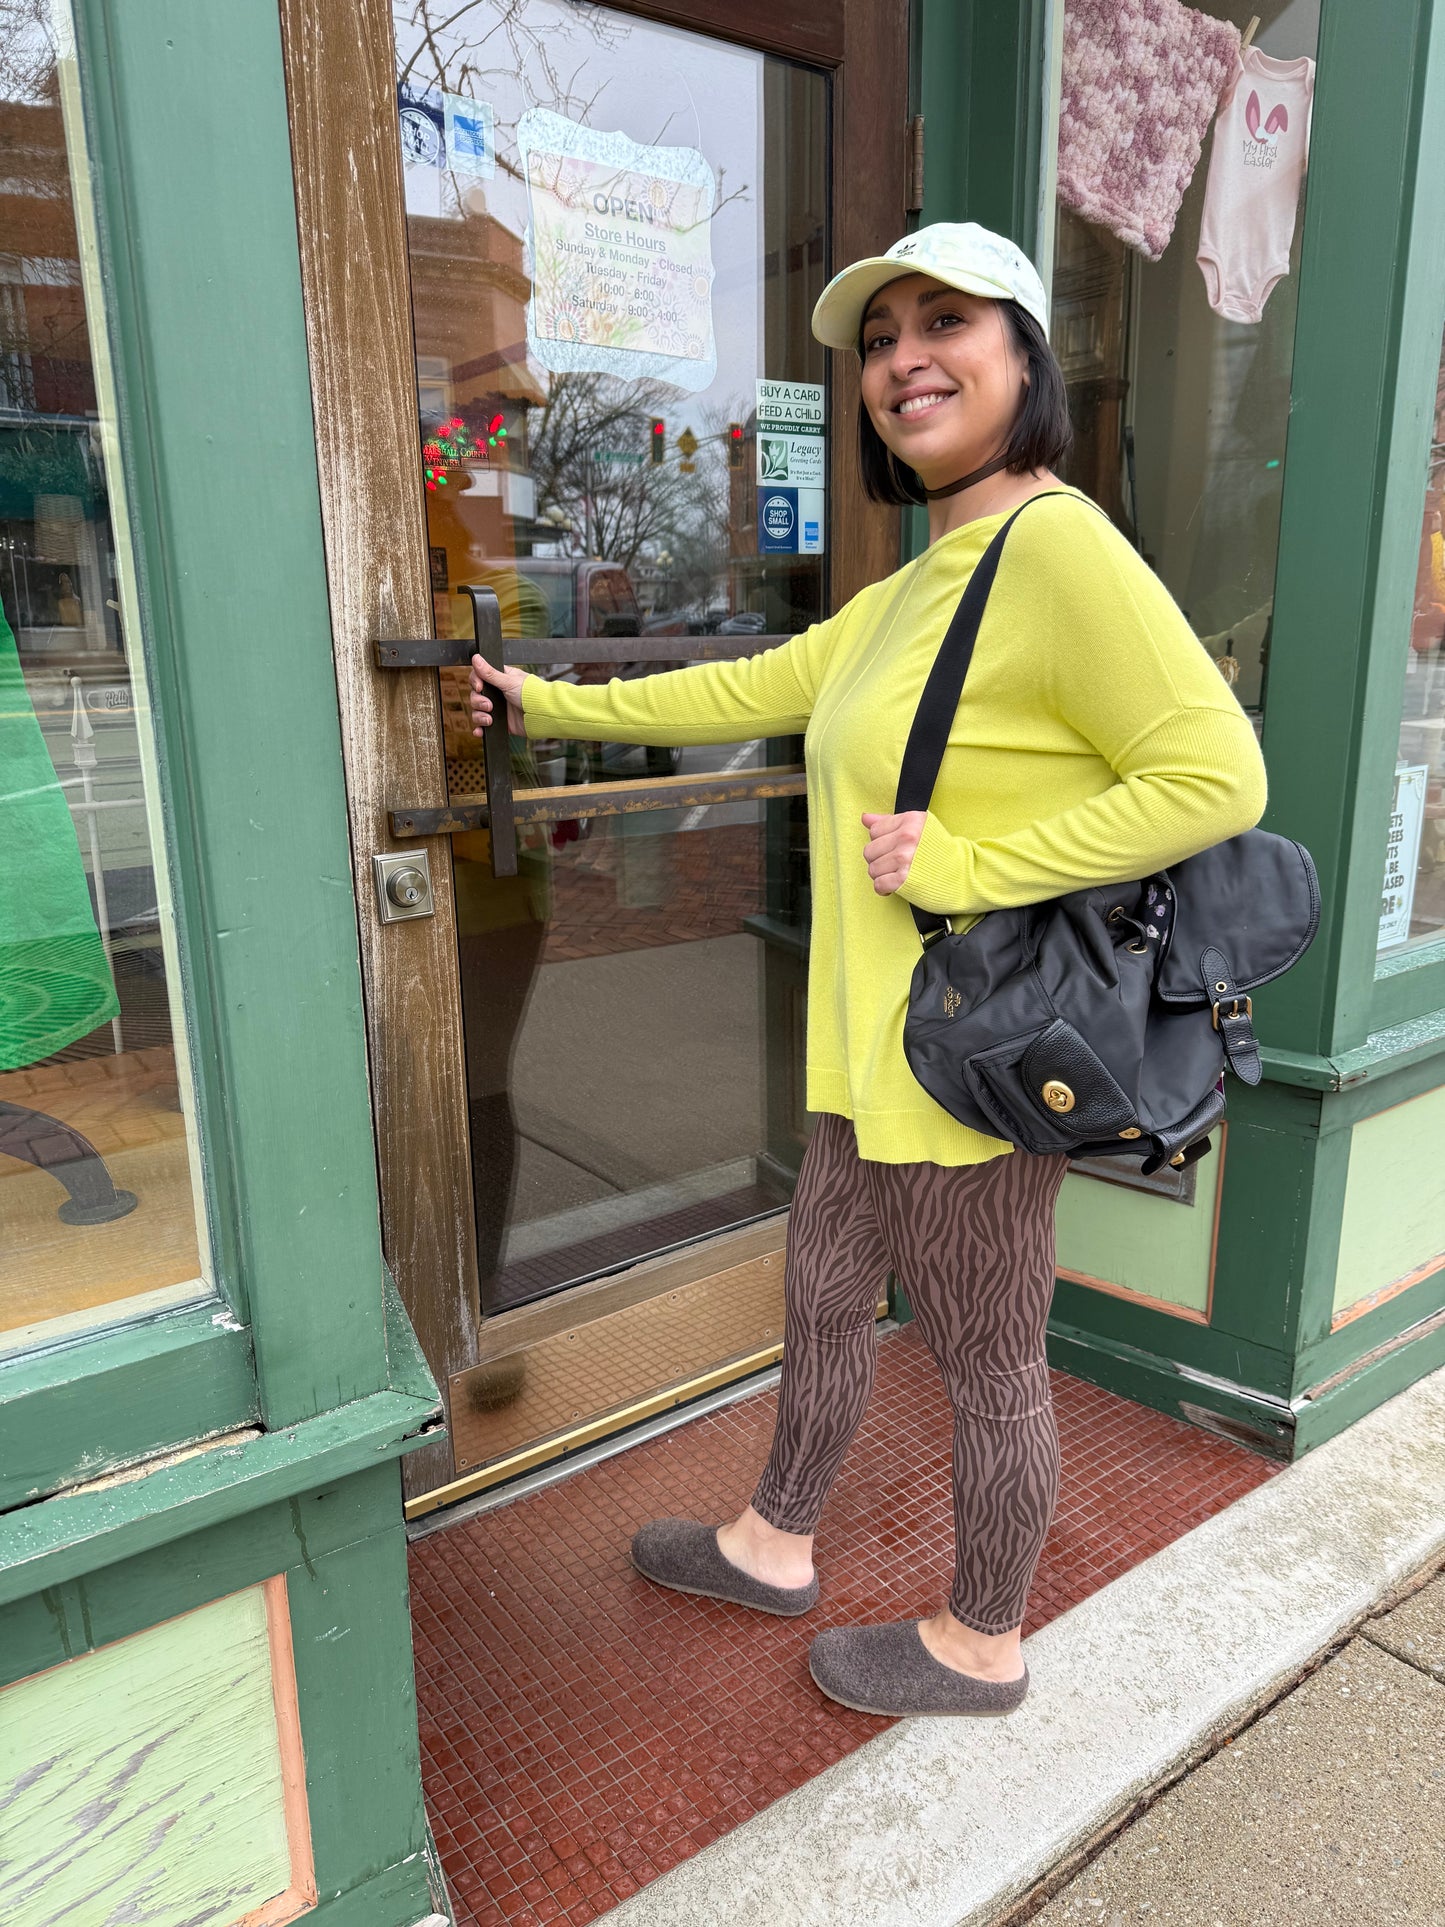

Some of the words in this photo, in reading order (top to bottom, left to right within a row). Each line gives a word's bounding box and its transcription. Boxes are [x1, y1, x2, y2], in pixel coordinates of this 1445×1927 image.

[1243, 140, 1257, 156] My
[1243, 152, 1275, 169] Easter
[593, 192, 654, 225] OPEN
[584, 222, 622, 243] Store
[626, 230, 667, 252] Hours
[555, 239, 596, 259] Sunday
[598, 247, 607, 258] &
[609, 249, 650, 269] Monday
[659, 258, 693, 275] Closed
[585, 261, 628, 282] Tuesday
[637, 271, 668, 290] Friday
[599, 282, 625, 297] 10:00
[634, 288, 655, 301] 6:00
[571, 294, 619, 315] Saturday
[628, 304, 648, 318] 9:00
[657, 309, 678, 322] 4:00
[760, 385, 782, 398] BUY
[783, 388, 791, 400] A
[793, 388, 821, 402] CARD
[759, 404, 783, 418] FEED
[784, 407, 793, 419] A
[794, 407, 822, 421] CHILD
[771, 424, 800, 432] PROUDLY
[800, 426, 821, 434] CARRY
[790, 441, 822, 458] Legacy
[768, 517, 789, 526] SMALL
[769, 509, 788, 518] SHOP
[1389, 860, 1399, 875] BE
